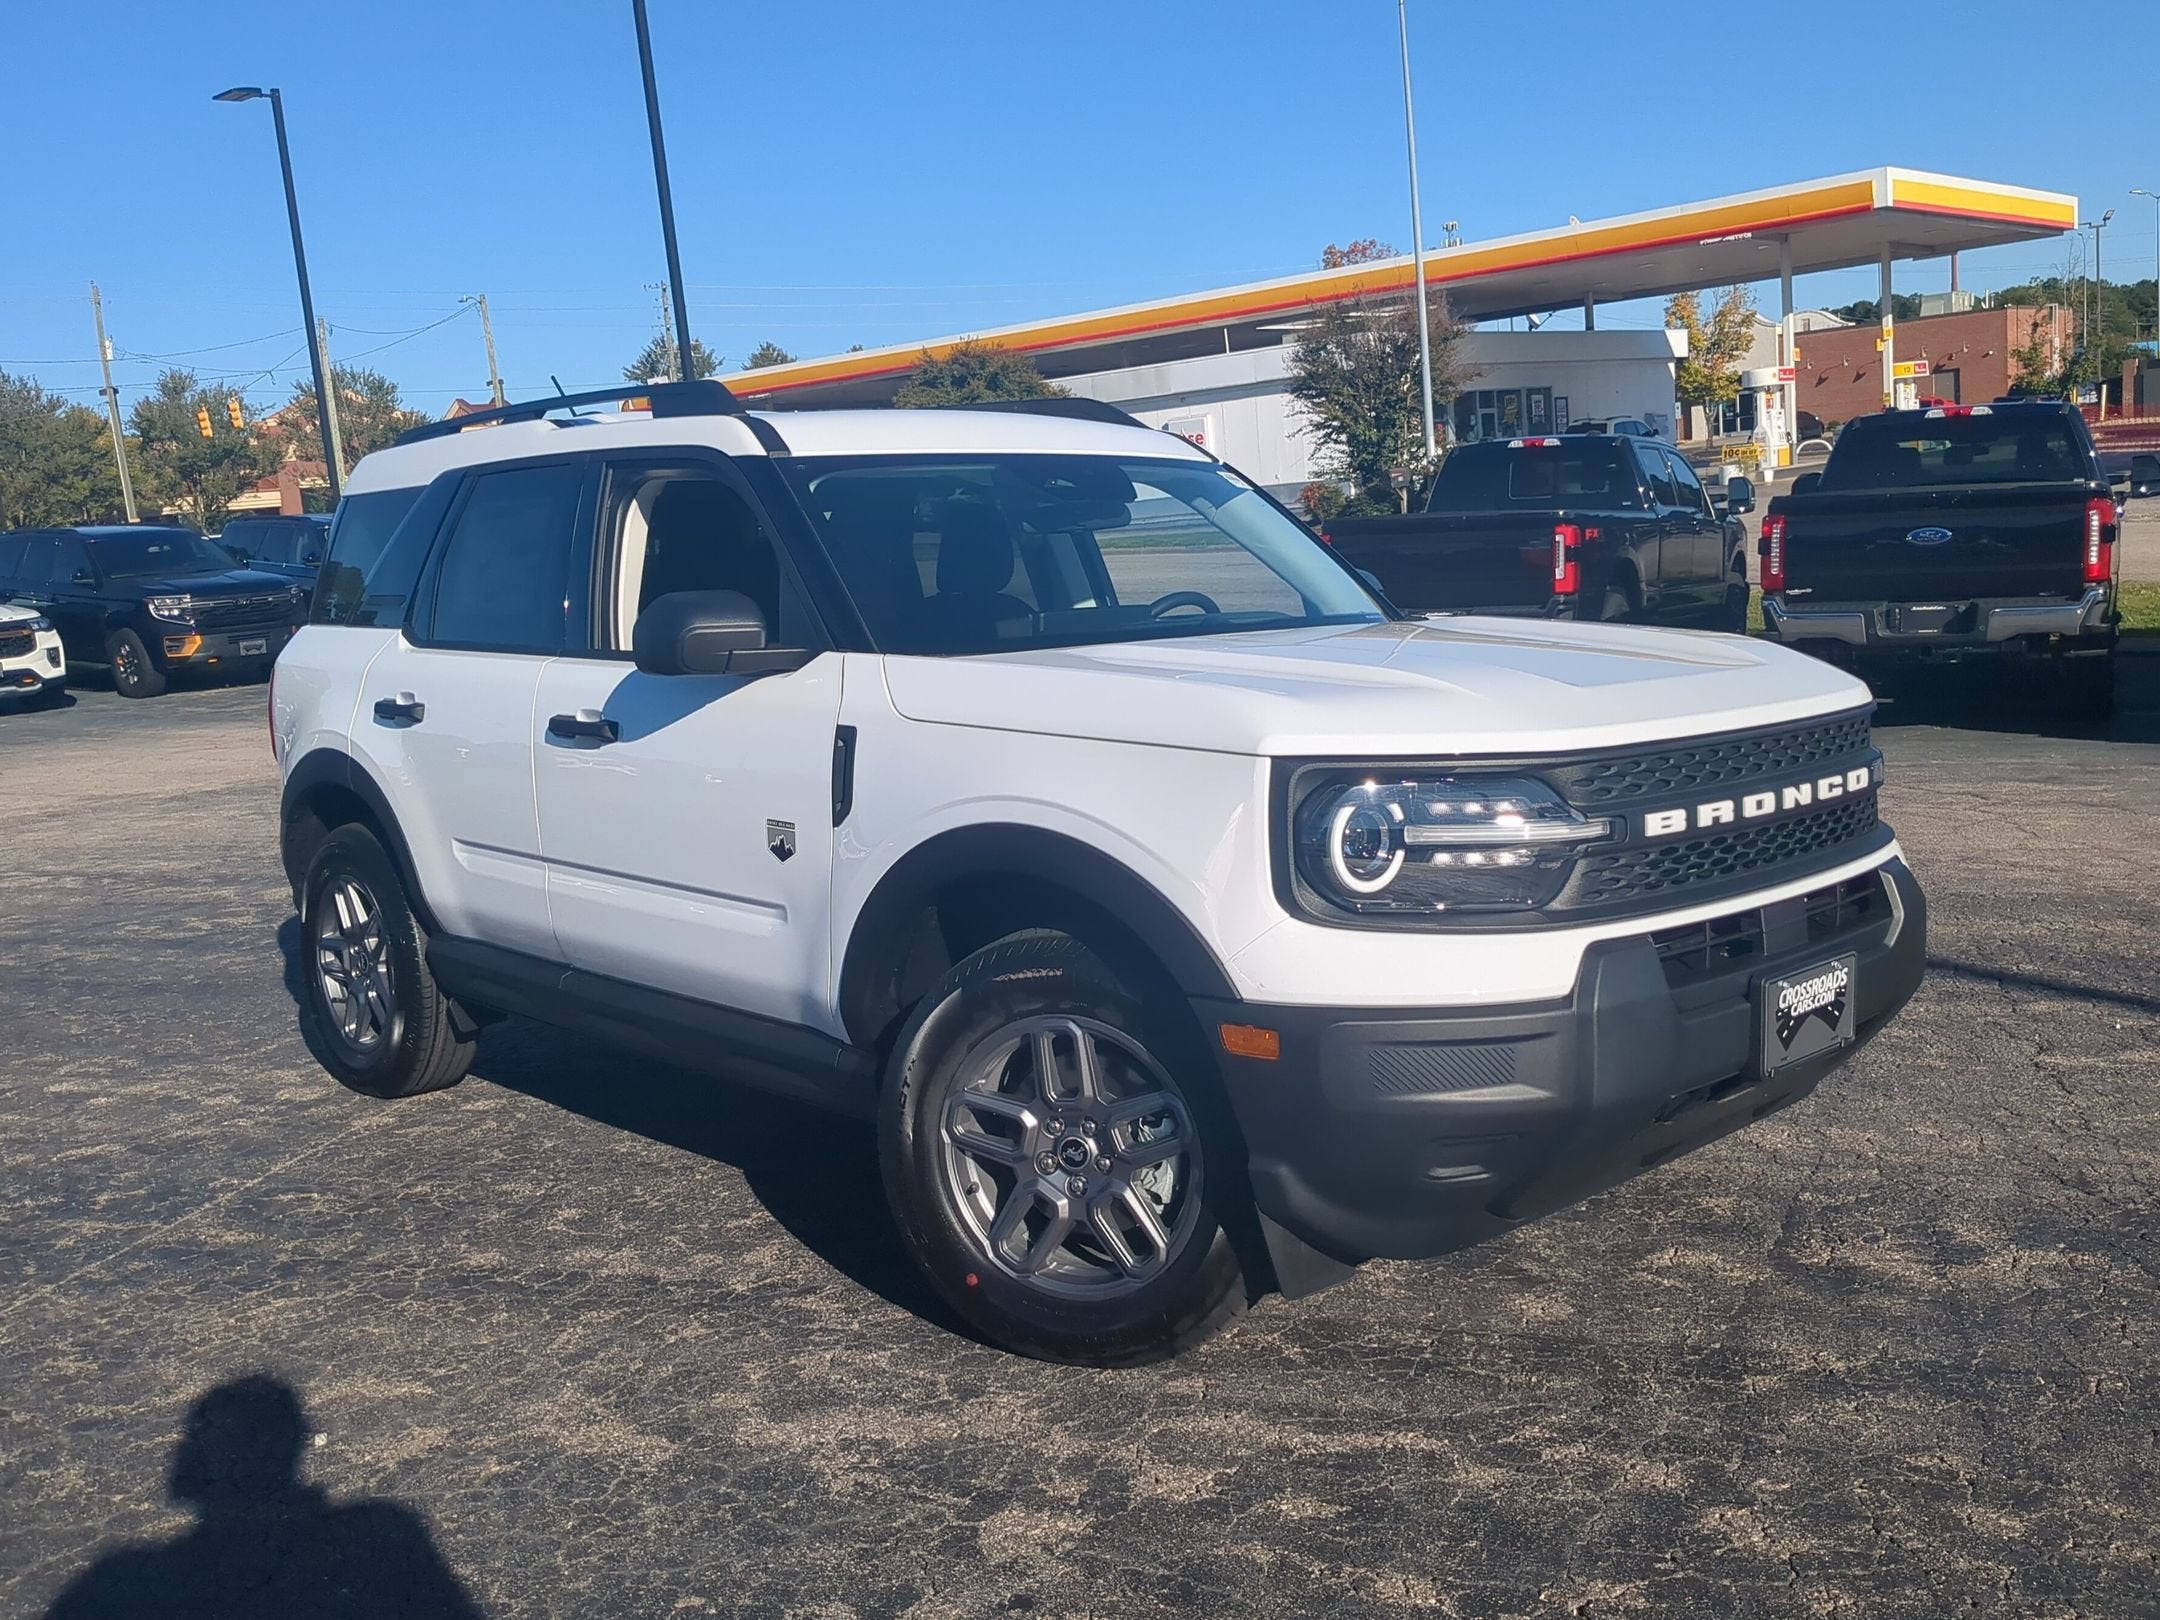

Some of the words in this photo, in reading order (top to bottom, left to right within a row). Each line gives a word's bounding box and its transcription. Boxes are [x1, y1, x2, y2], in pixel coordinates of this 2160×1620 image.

[1644, 767, 1869, 837] BRONCO
[1779, 967, 1848, 1009] CROSSROADS
[1790, 989, 1836, 1017] CARS.COM
